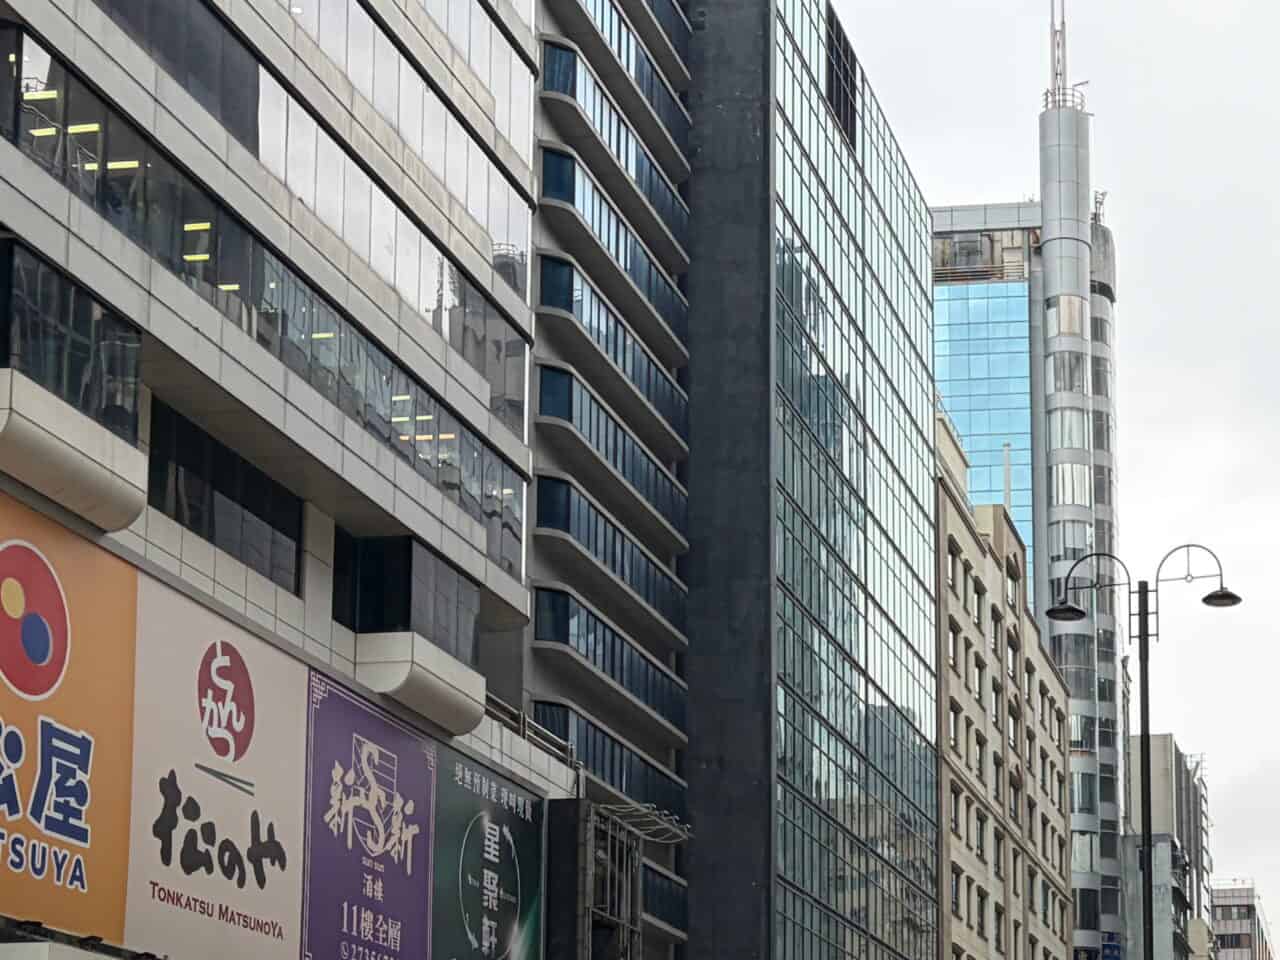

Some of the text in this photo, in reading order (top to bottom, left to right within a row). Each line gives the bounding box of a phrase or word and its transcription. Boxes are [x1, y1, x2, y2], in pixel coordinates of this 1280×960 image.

[149, 880, 215, 918] TONKATSU
[341, 901, 401, 952] 11樓全層
